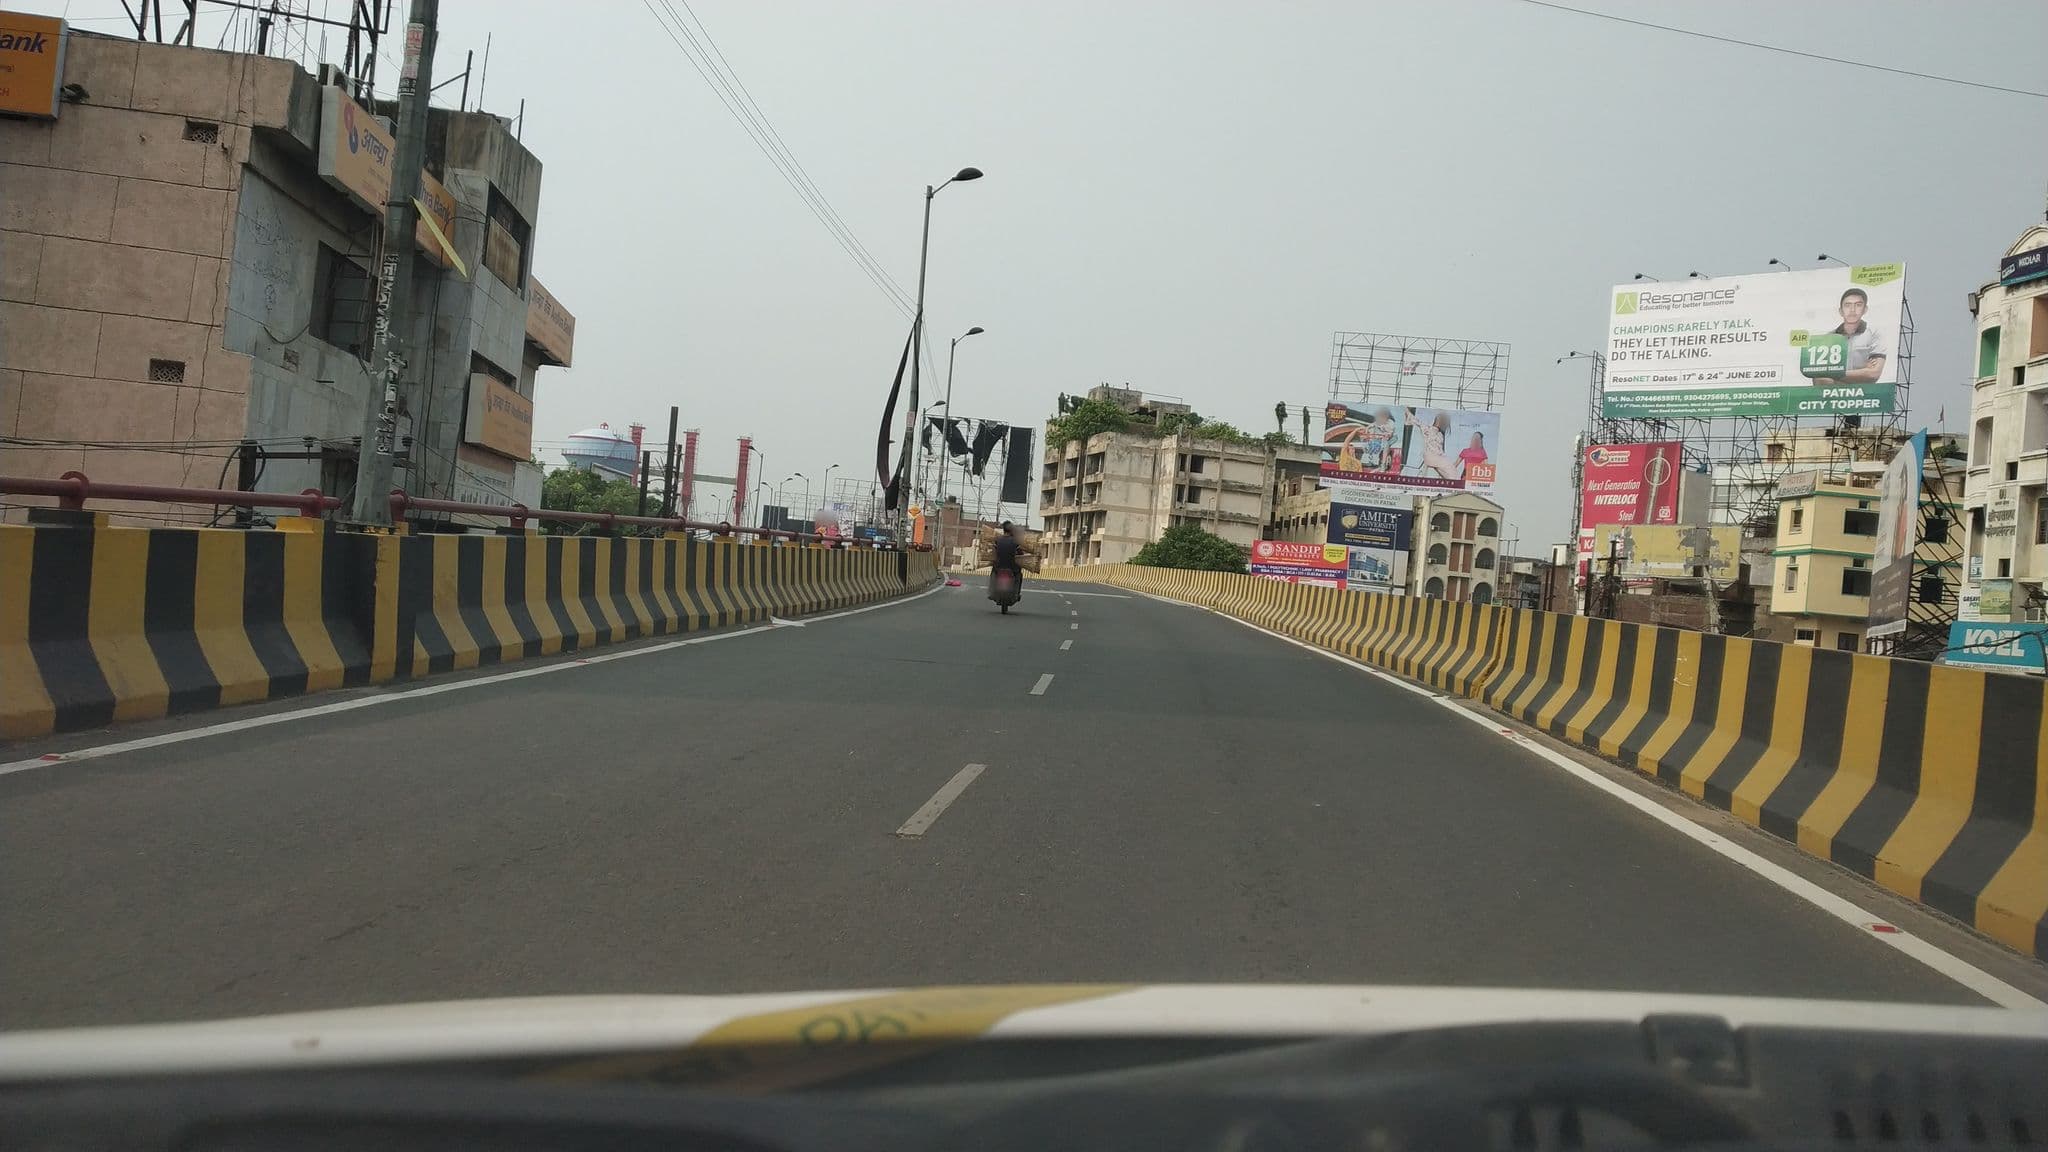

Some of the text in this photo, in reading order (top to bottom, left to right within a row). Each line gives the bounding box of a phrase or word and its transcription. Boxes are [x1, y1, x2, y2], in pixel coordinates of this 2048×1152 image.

[0, 30, 48, 54] ank
[1640, 289, 1735, 304] Resonance
[1640, 303, 1670, 311] Educating
[1613, 319, 1754, 335] CHAMPIONS RARELY TALK.
[1613, 332, 1767, 349] THEY LET THEIR RESULTS
[1611, 348, 1712, 361] DO THE TALKING.
[1808, 344, 1842, 365] 128
[1823, 388, 1864, 398] PATNA
[1799, 399, 1880, 410] CITY TOPPER
[1472, 466, 1492, 477] fbb
[1587, 478, 1640, 491] Next Generation
[1594, 493, 1638, 505] INTERLOCK
[1360, 510, 1396, 523] AMITY
[1618, 508, 1636, 521] Steel
[1359, 520, 1395, 530] UNIVERSITY
[1276, 544, 1321, 554] SANDIP
[1963, 628, 2025, 657] KOEL
